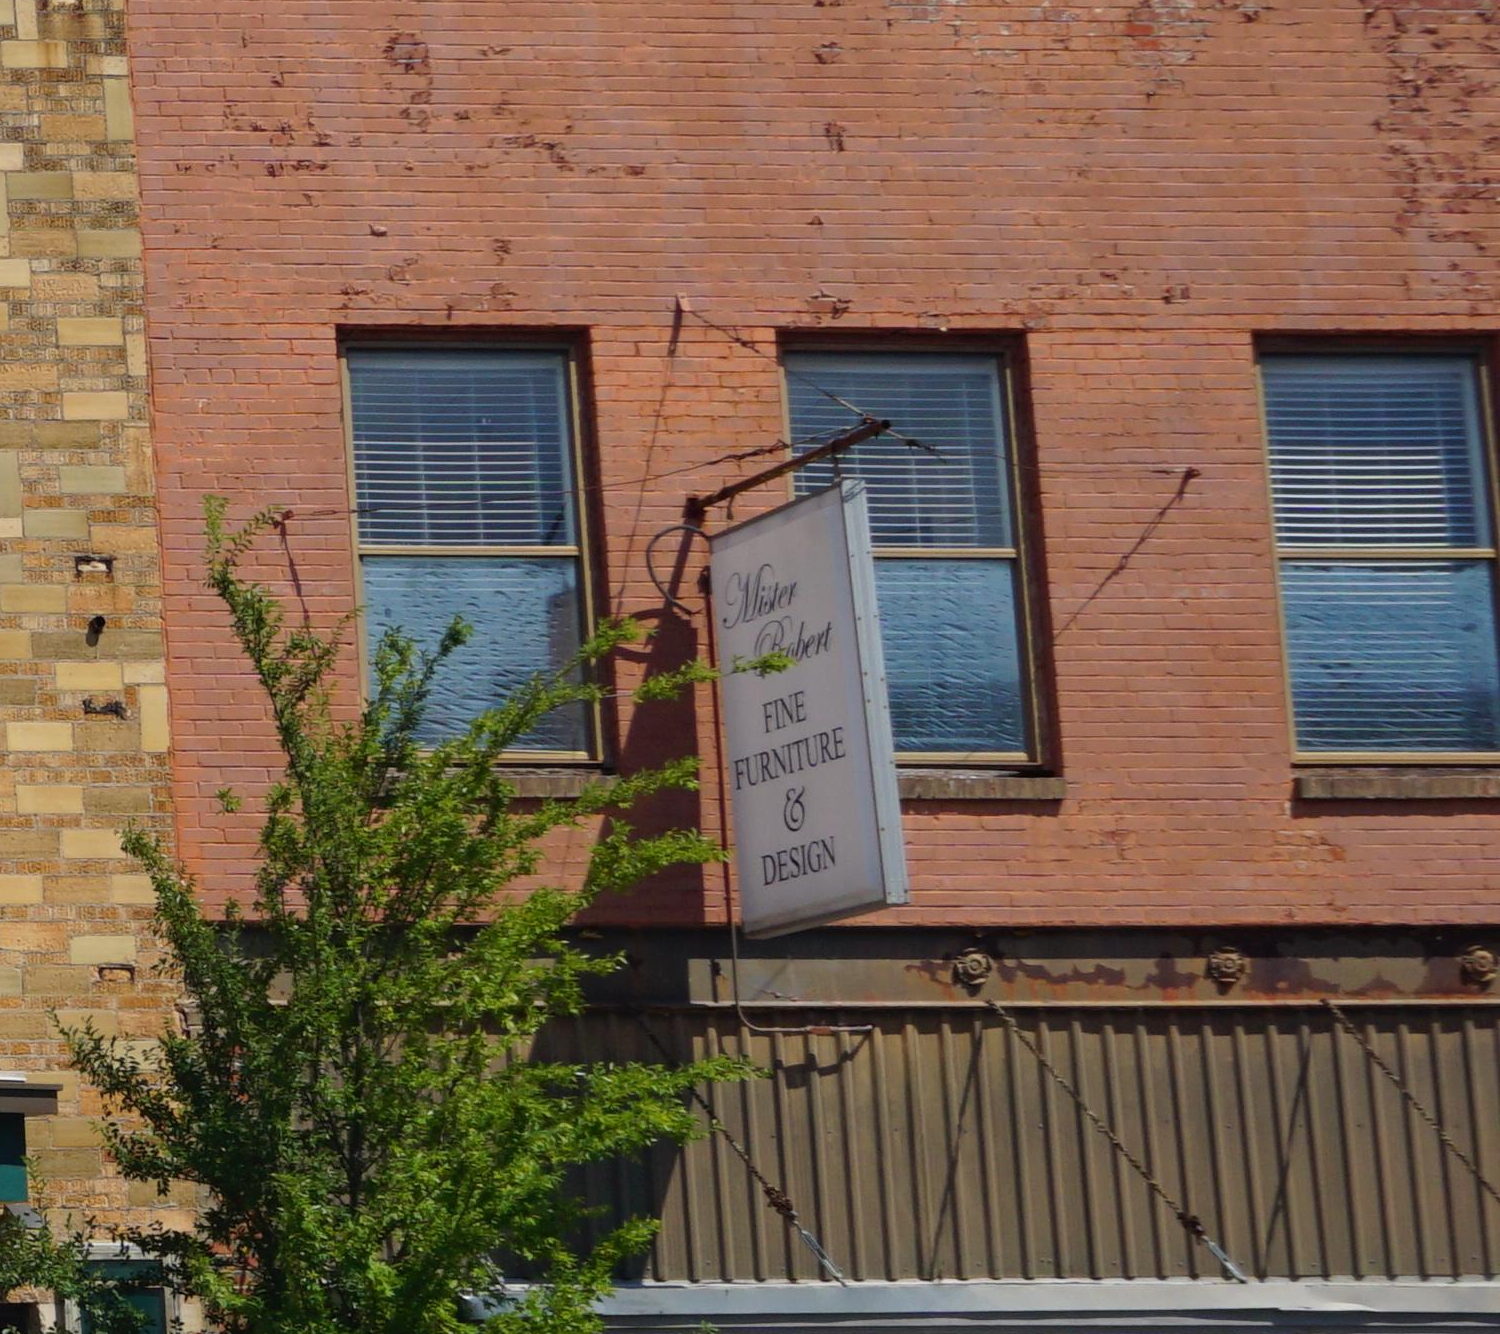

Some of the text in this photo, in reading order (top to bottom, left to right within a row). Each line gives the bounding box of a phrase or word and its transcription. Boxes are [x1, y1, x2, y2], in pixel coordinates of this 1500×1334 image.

[722, 564, 797, 629] Mister
[762, 691, 807, 733] FINE
[734, 726, 846, 791] FURNITURE
[783, 786, 806, 832] &
[761, 835, 837, 886] DESIGN
